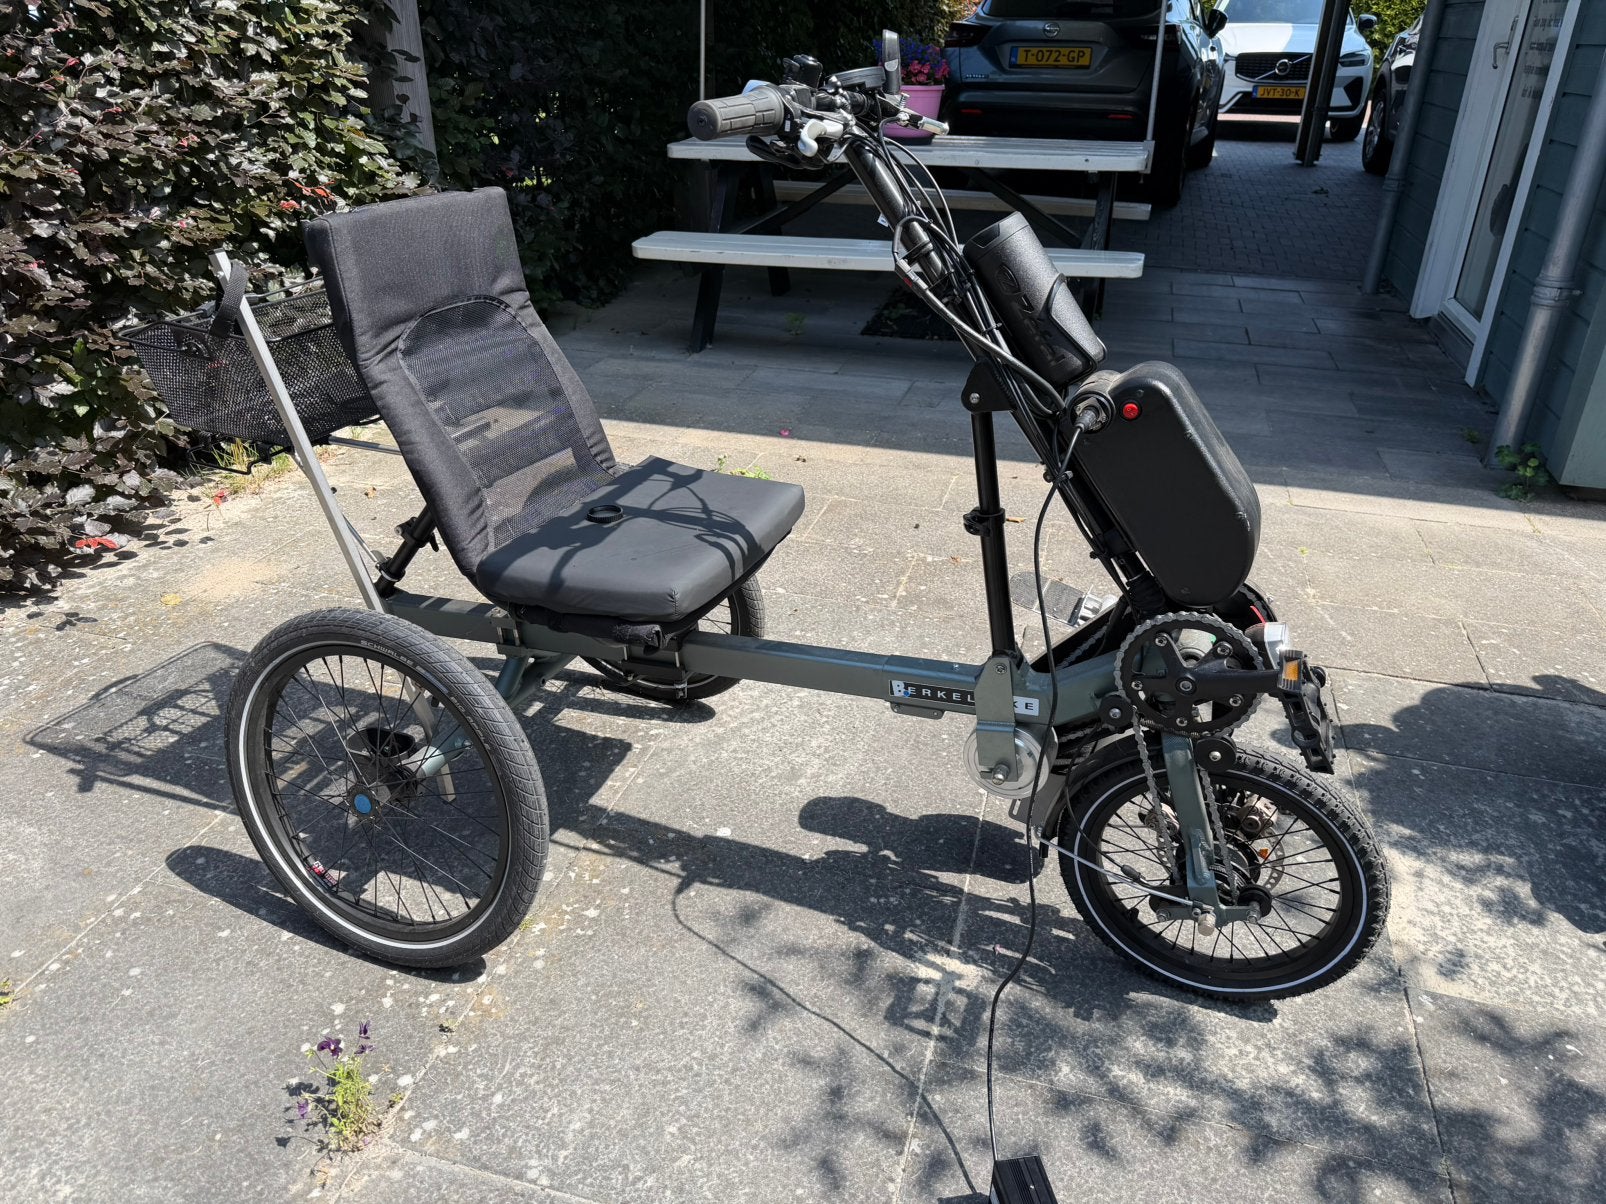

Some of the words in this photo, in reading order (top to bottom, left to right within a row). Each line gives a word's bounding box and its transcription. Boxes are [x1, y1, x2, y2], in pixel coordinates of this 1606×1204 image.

[1023, 49, 1086, 63] T-072-GP
[1260, 87, 1301, 97] JVT-30-K
[360, 640, 414, 666] SCHWALBE
